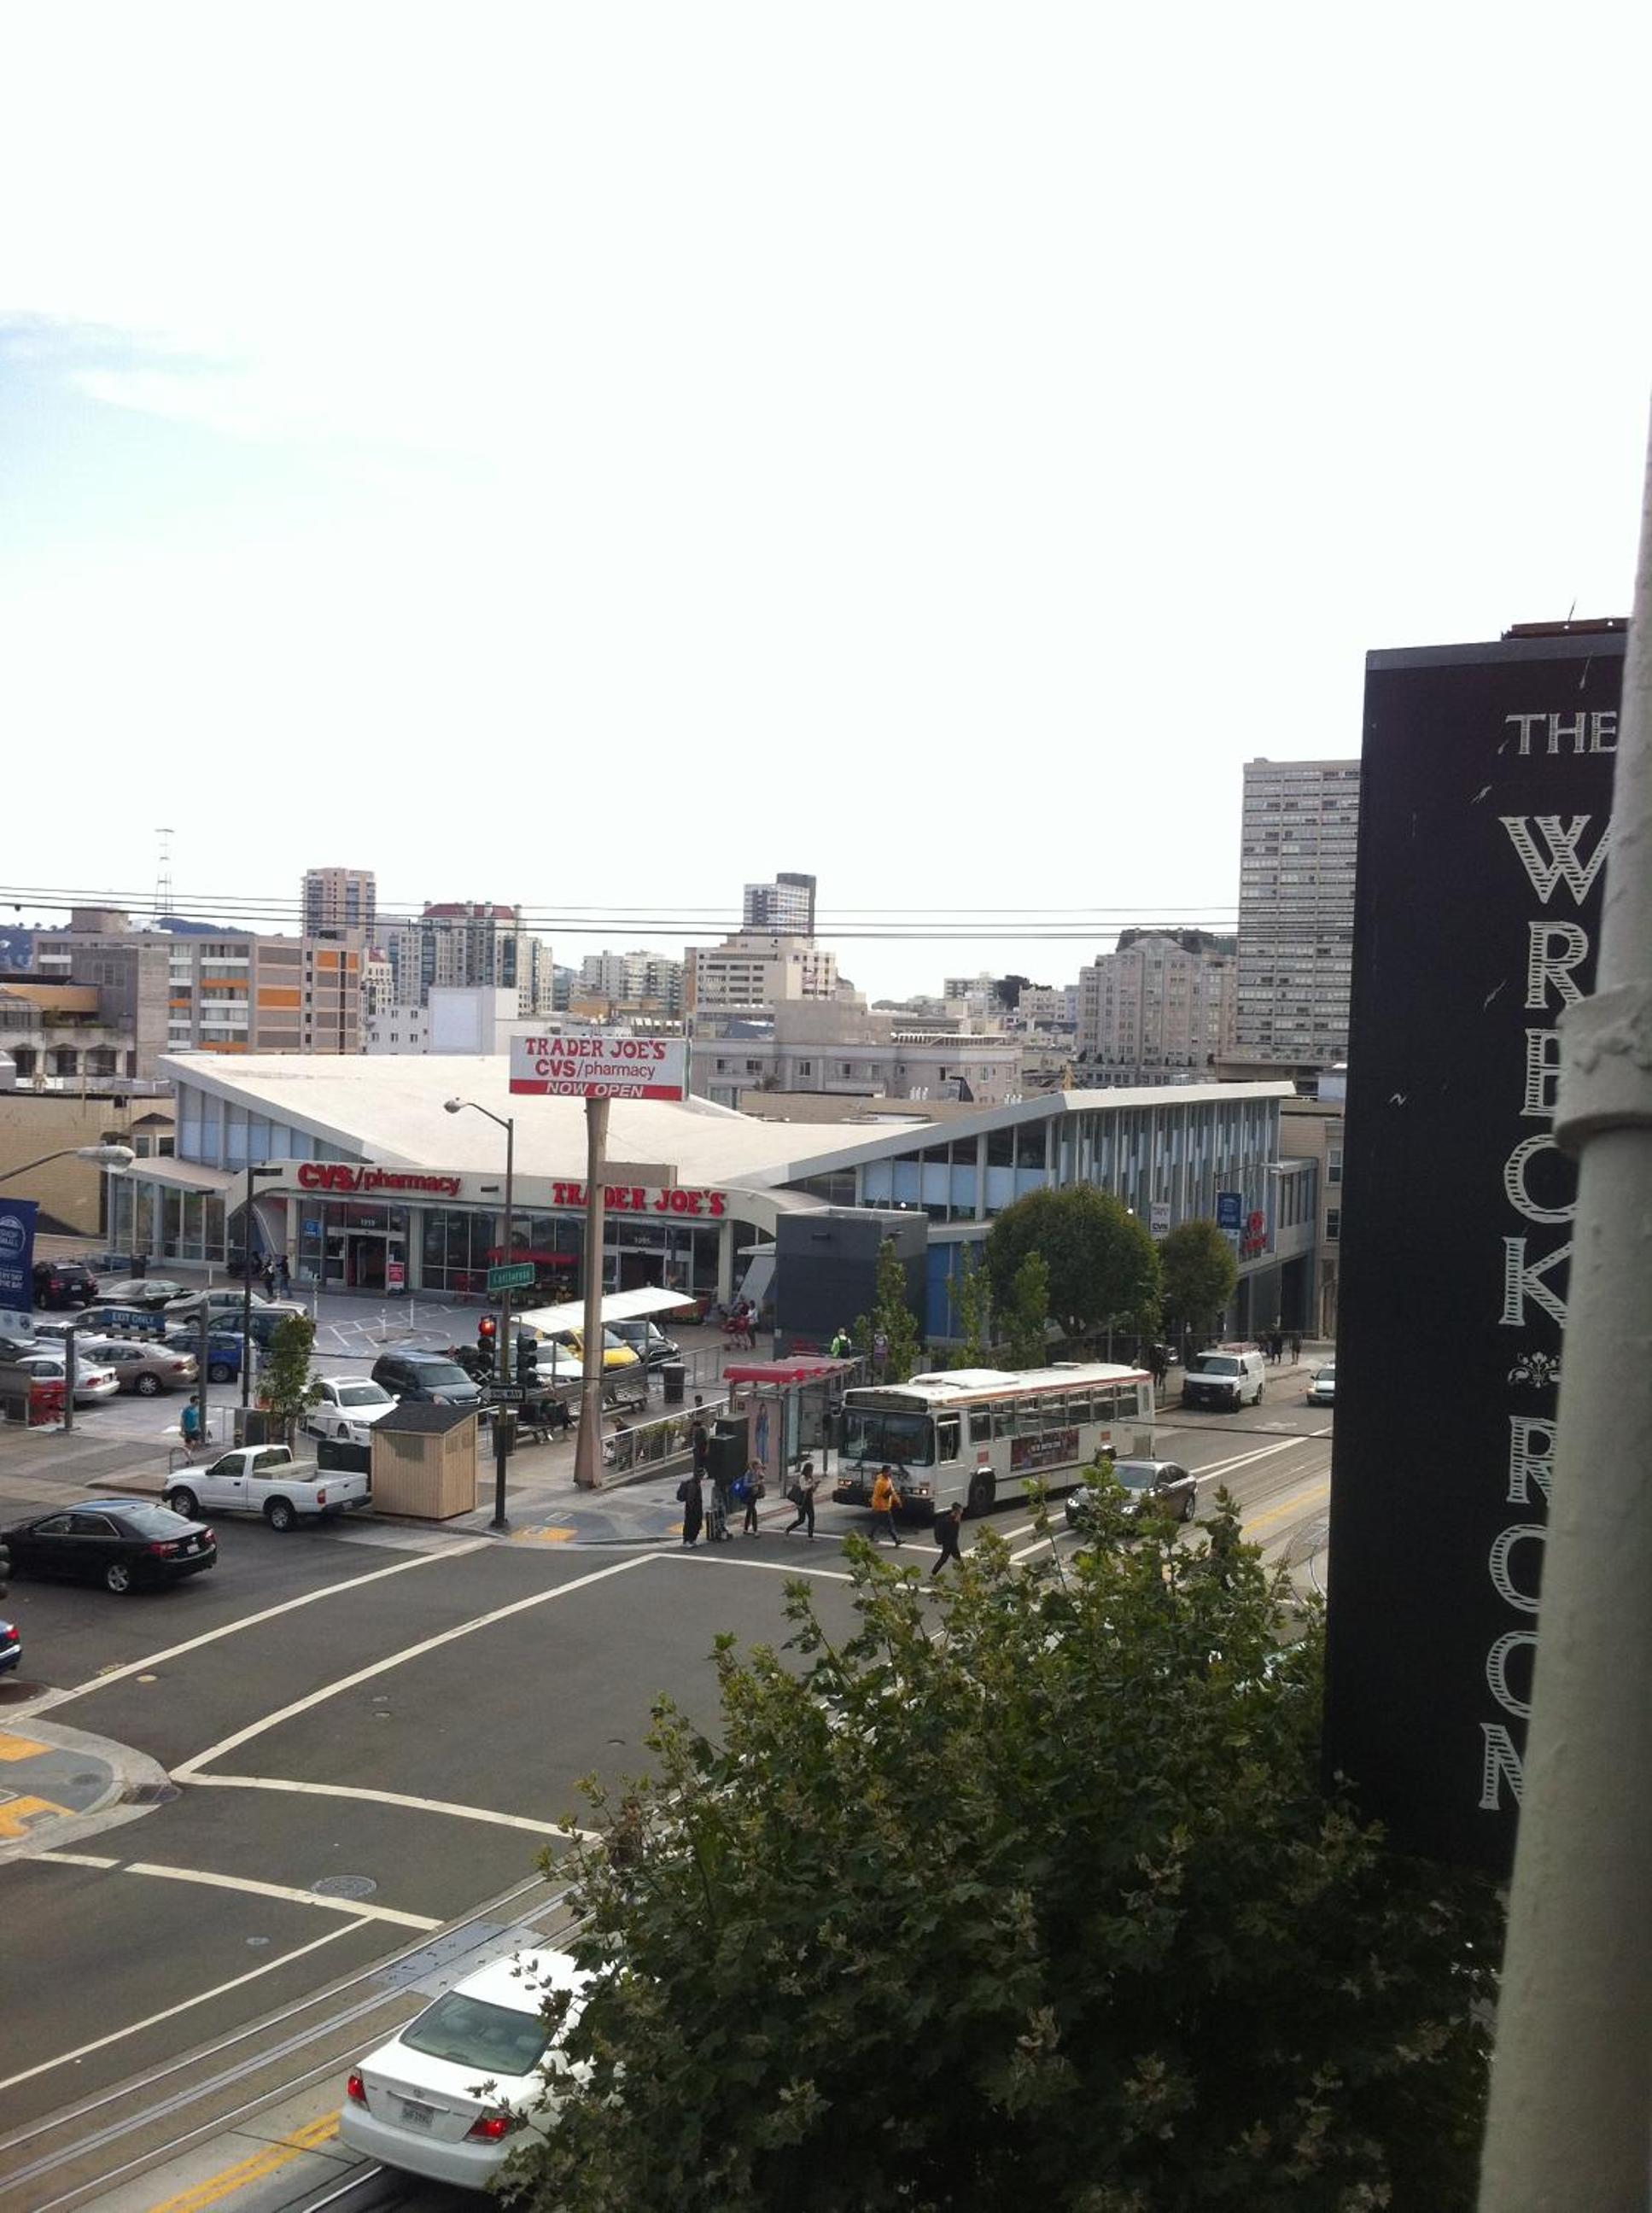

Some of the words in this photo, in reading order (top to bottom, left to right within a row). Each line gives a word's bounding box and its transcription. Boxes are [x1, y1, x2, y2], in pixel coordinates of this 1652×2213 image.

[1505, 711, 1617, 755] THE
[525, 1037, 604, 1058] TRADER
[610, 1039, 667, 1060] JOE'S
[535, 1058, 656, 1081] CVS/pharmacy
[546, 1081, 587, 1095] NOW
[593, 1083, 644, 1098] OPEN
[297, 1162, 462, 1197] CVS/pharmacy
[654, 1188, 727, 1217] JOE'S
